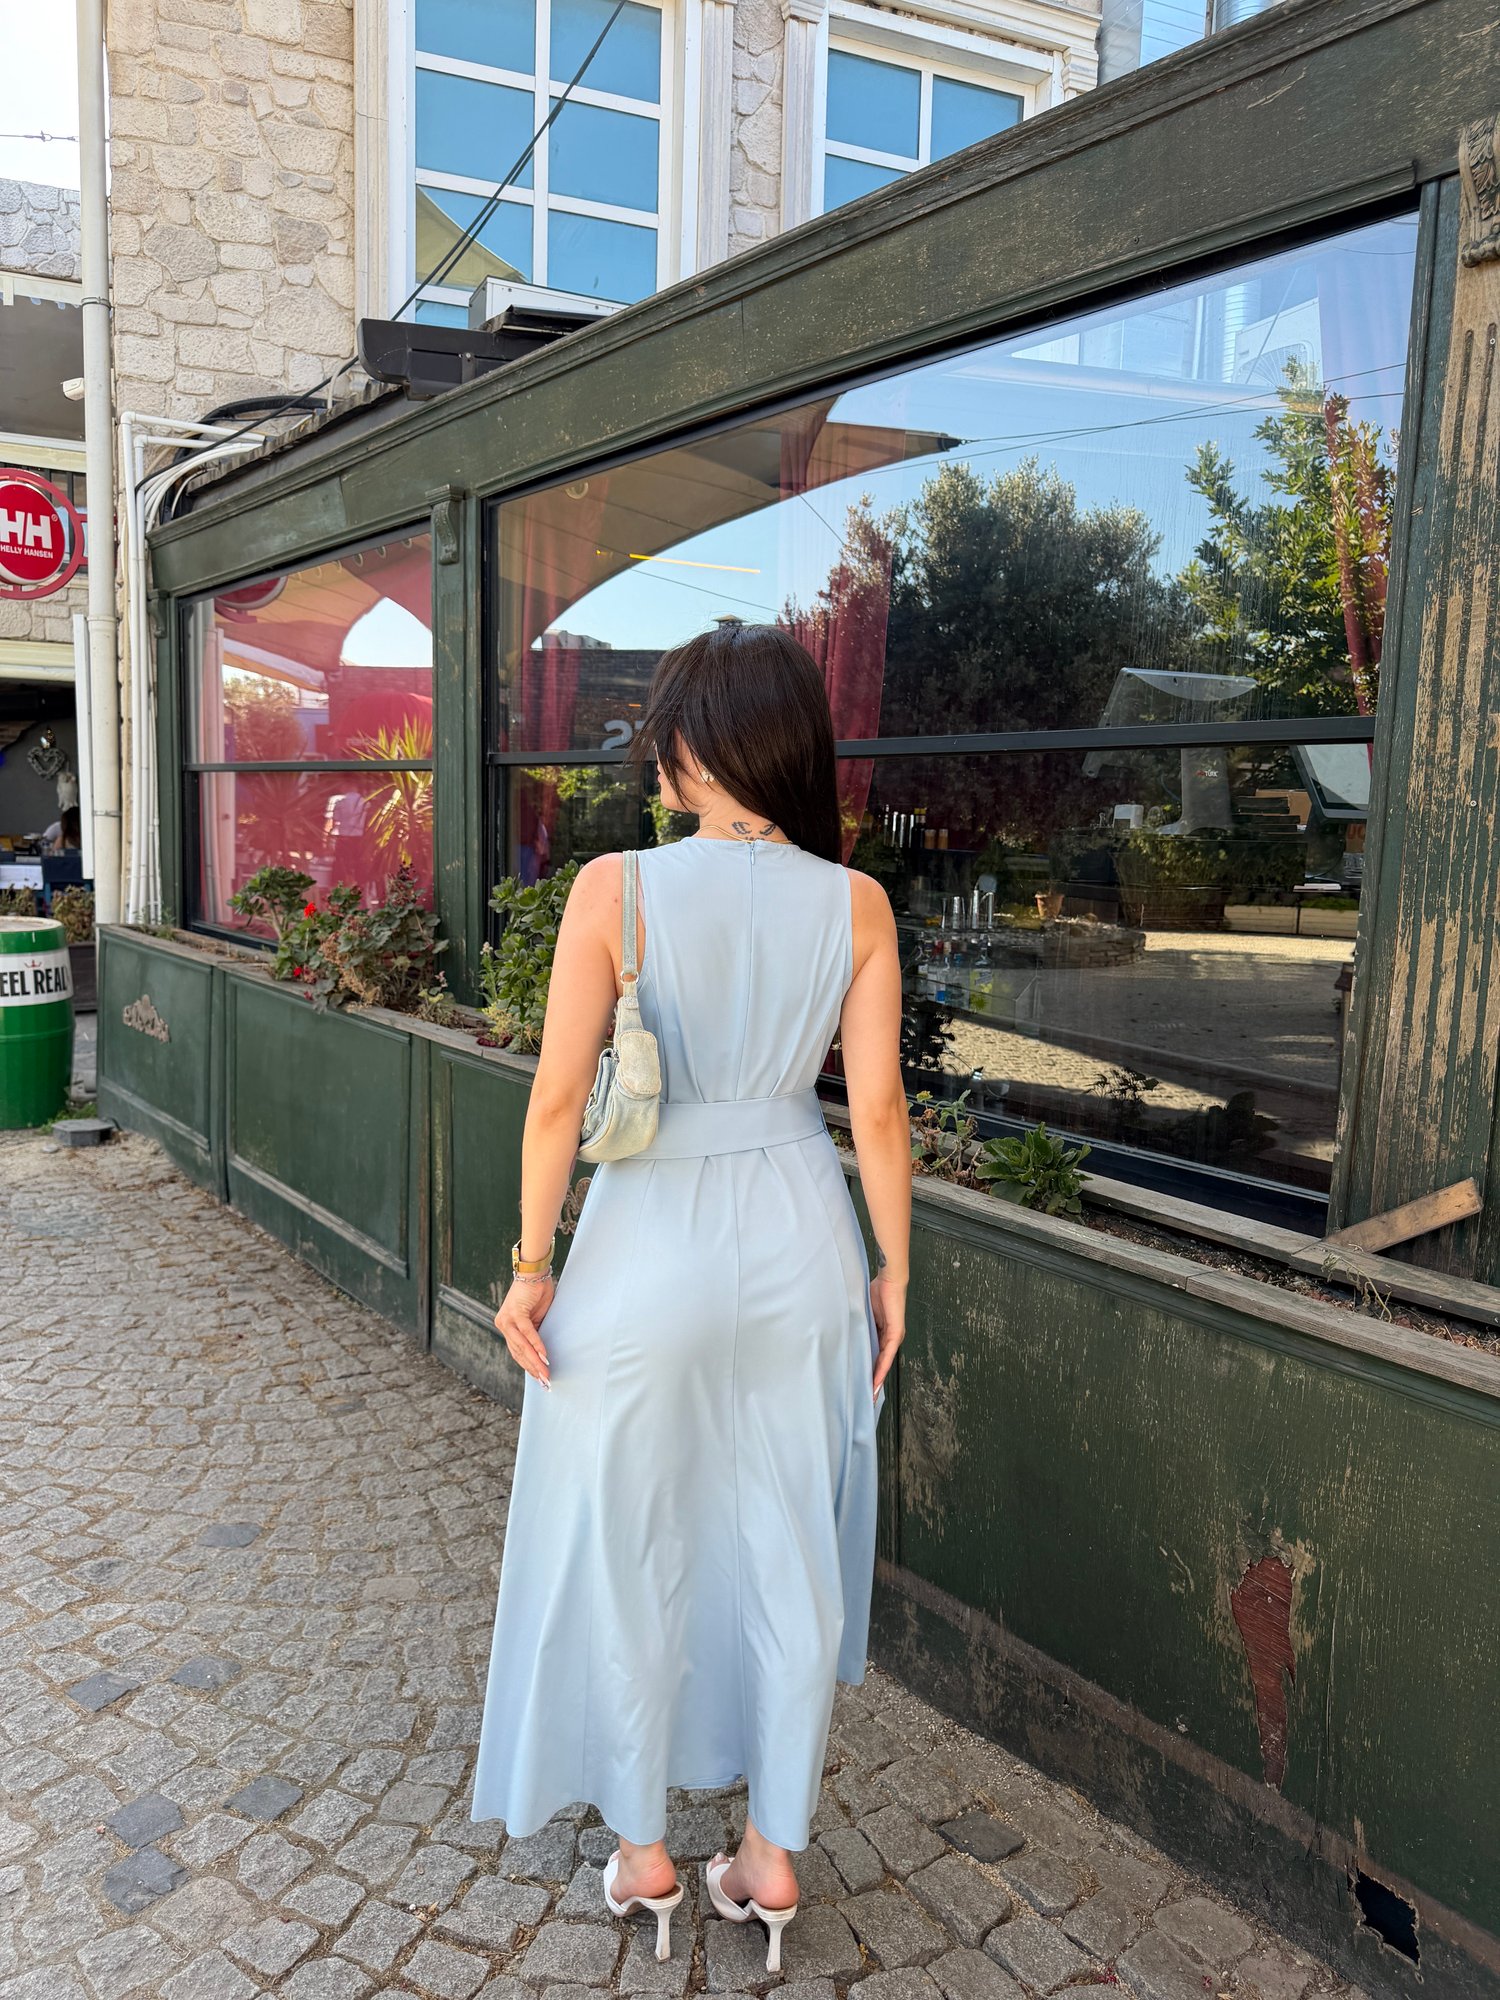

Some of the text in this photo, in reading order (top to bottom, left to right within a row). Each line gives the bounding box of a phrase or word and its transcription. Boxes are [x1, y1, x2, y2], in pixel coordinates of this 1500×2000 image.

[0, 545, 54, 559] HELLY HANSEN
[33, 966, 68, 994] REAL
